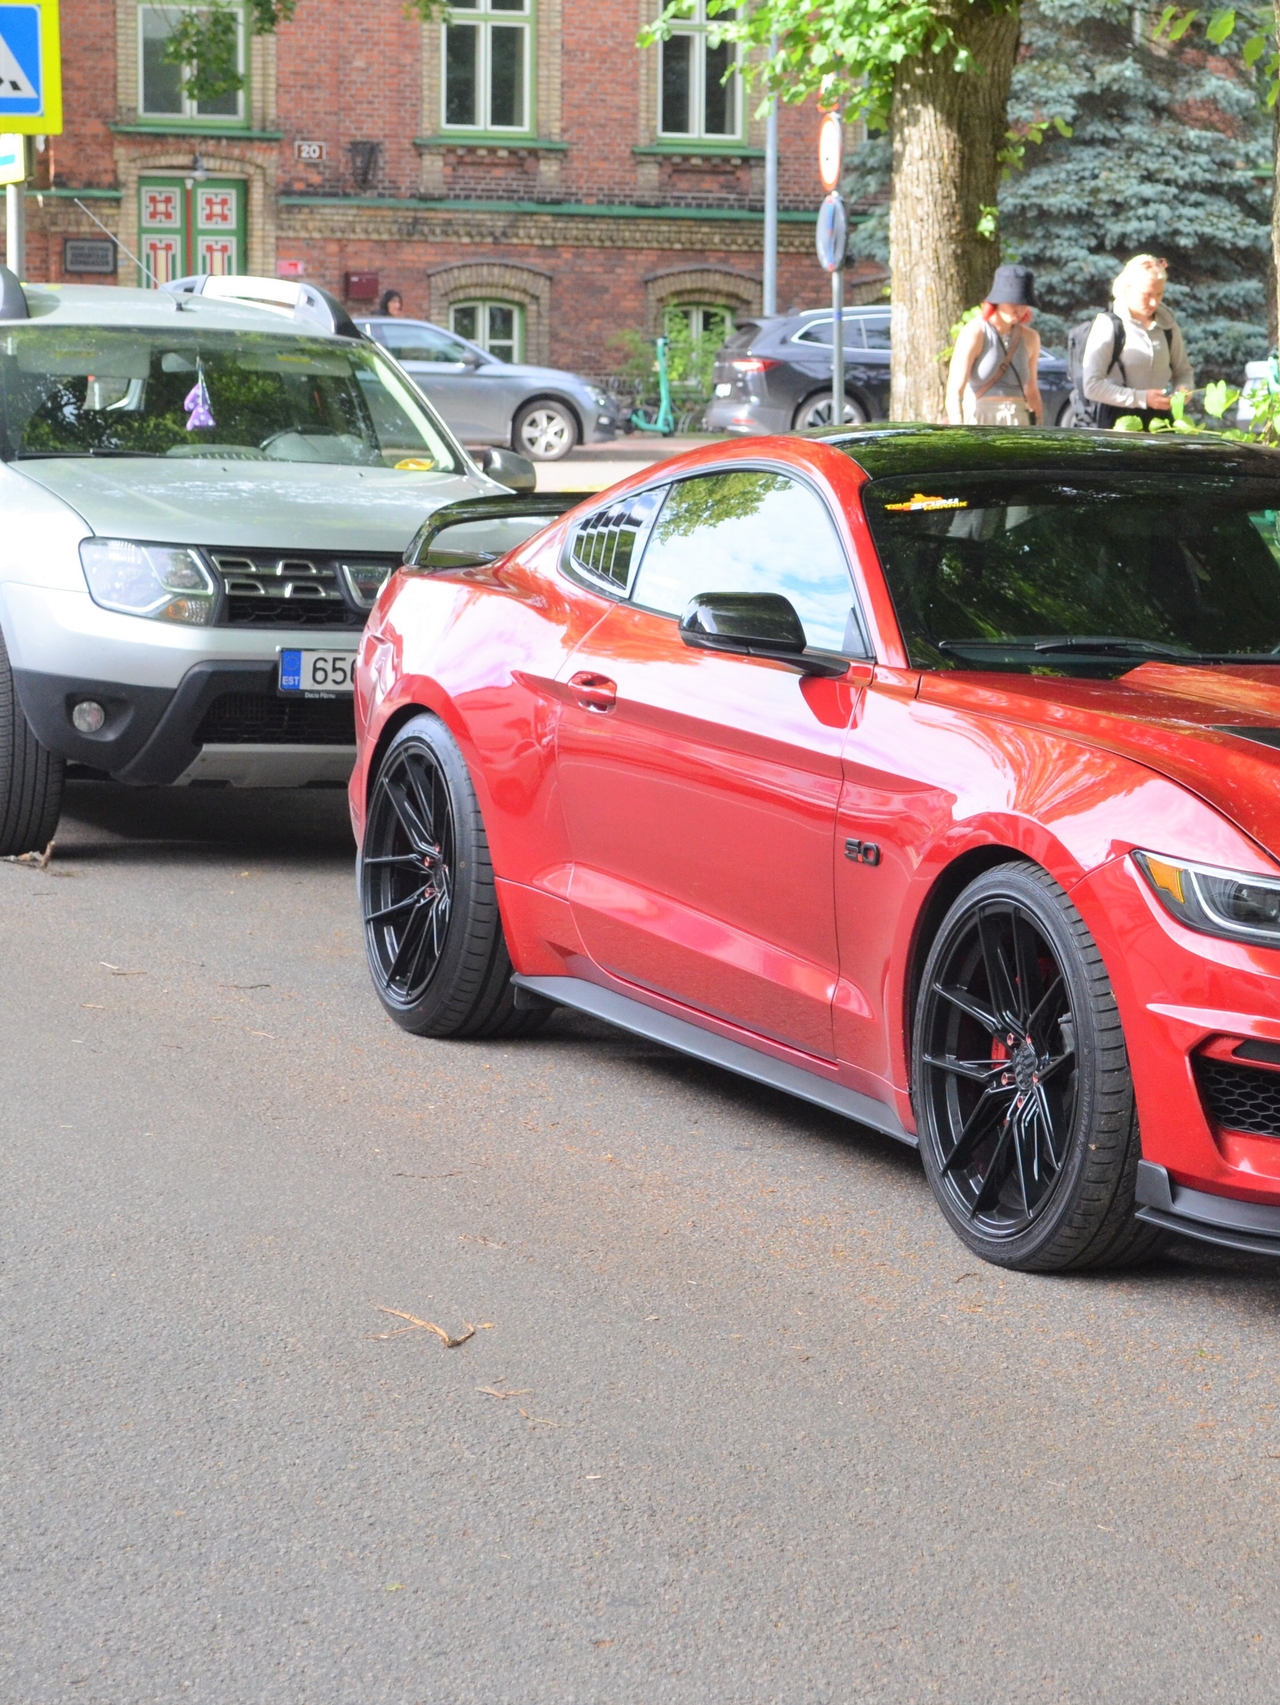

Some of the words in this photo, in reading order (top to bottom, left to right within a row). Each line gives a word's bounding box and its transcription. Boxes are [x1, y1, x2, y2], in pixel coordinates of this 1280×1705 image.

[300, 144, 320, 158] 20
[282, 676, 300, 686] EST
[844, 838, 881, 867] 5.0
